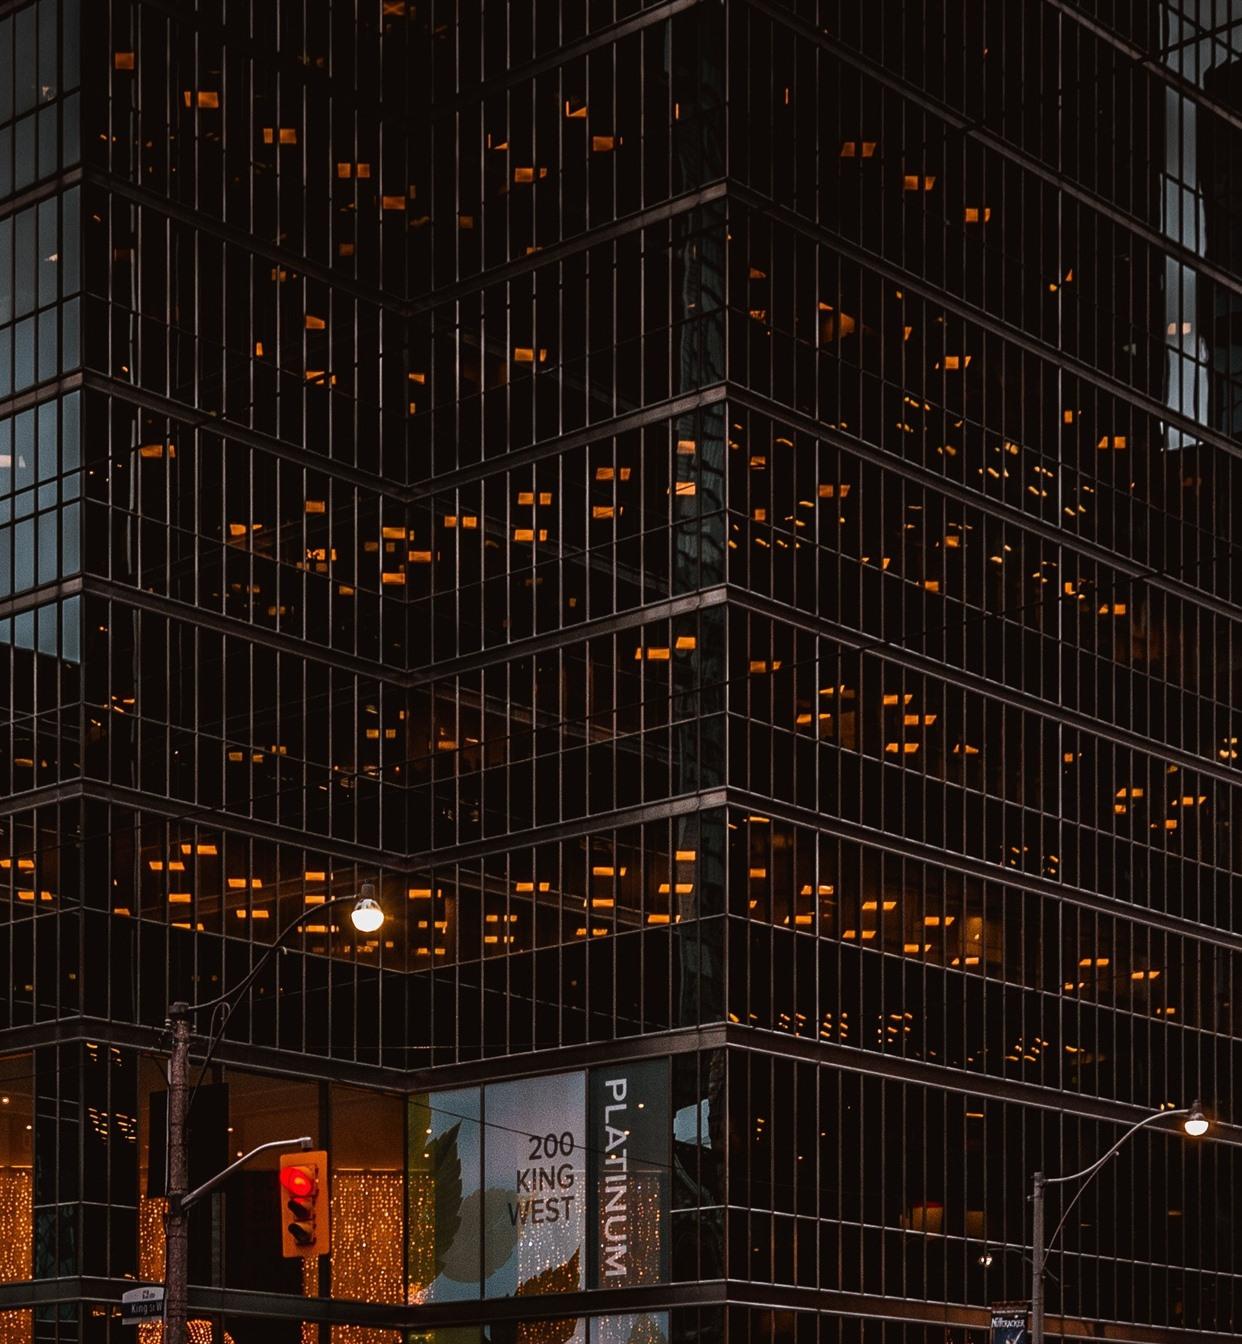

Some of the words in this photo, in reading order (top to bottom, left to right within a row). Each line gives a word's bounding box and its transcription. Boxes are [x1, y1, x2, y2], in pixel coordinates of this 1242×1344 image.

[529, 1131, 575, 1160] 200
[516, 1163, 575, 1193] KING
[604, 1078, 628, 1277] PLATINUM
[508, 1195, 575, 1226] WEST
[131, 1303, 148, 1315] King
